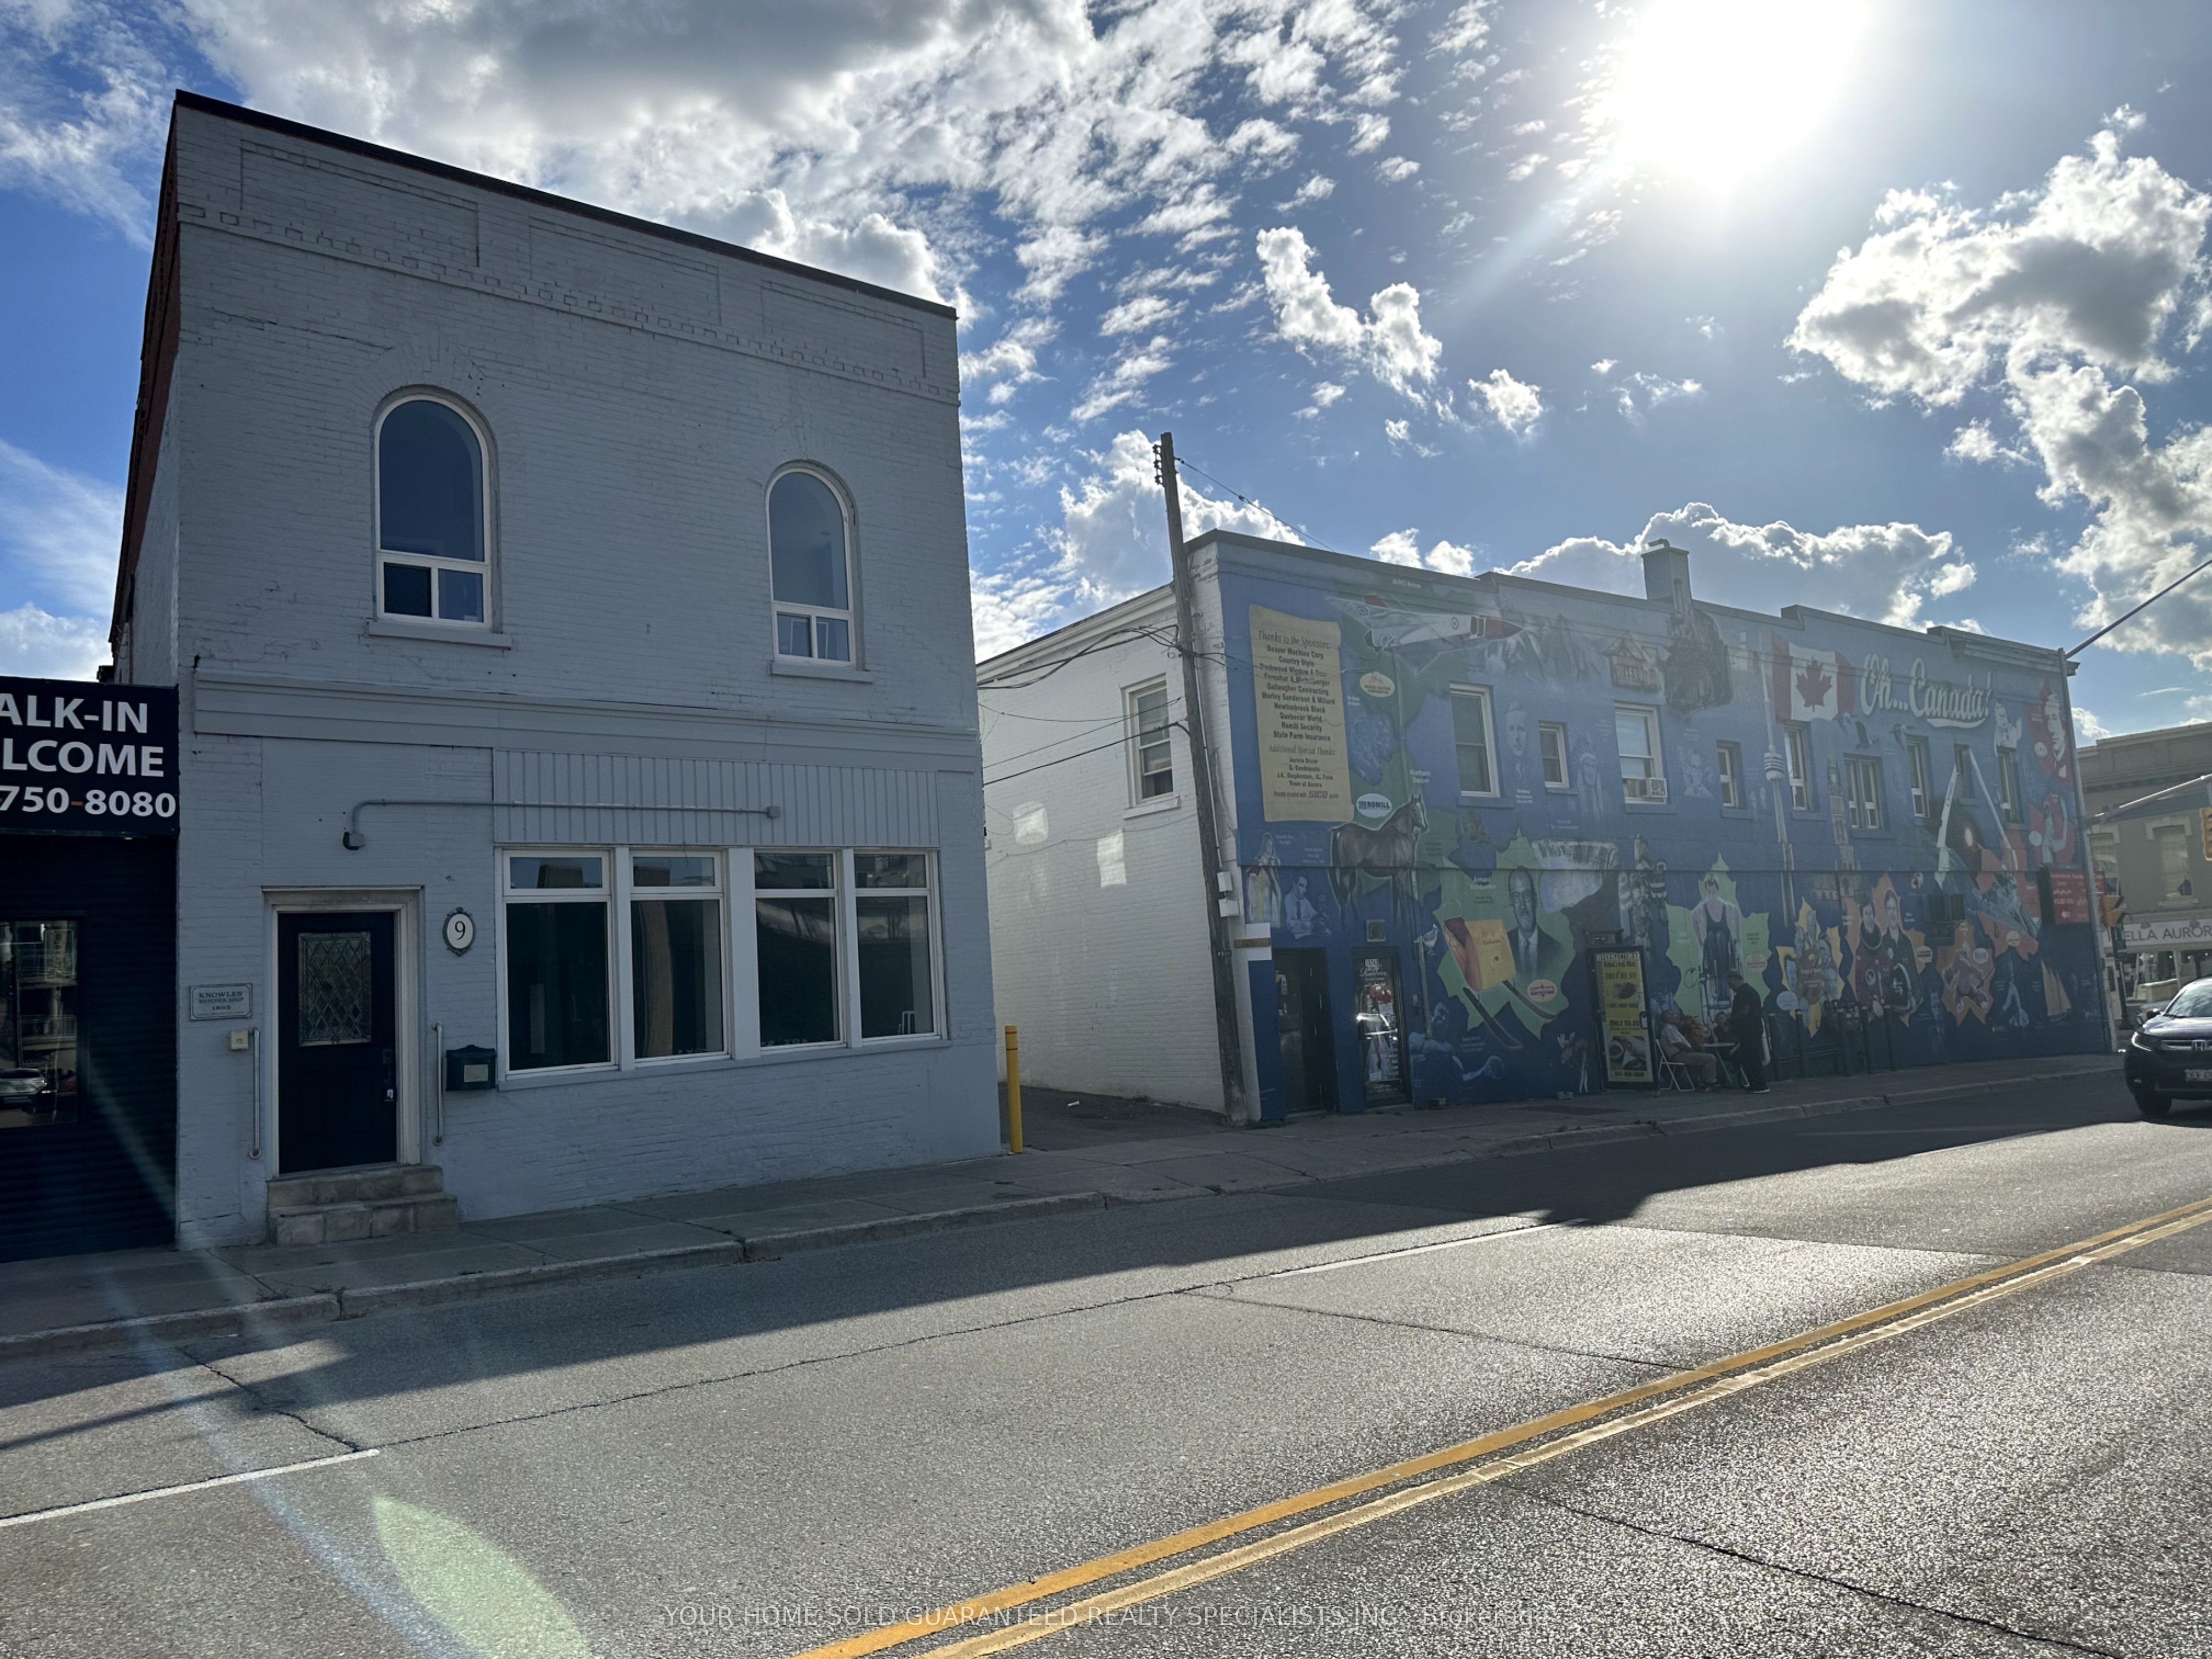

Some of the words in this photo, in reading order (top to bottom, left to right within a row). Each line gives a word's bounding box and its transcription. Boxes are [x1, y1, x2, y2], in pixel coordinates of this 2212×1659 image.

[1258, 630, 1281, 641] Thanks
[1291, 635, 1300, 643] the
[1267, 645, 1286, 653] Beaver
[1287, 647, 1309, 657] Machine
[1310, 651, 1324, 660] Corp
[1279, 656, 1300, 666] Country
[1301, 658, 1314, 667] Style
[1298, 685, 1329, 696] Contracting
[1909, 658, 1991, 720] Canada!
[1282, 693, 1310, 702] Sanderson
[1300, 723, 1322, 733] Security
[1290, 732, 1303, 740] Farm
[1305, 733, 1331, 741] Insurance
[1366, 801, 1391, 809] ROMILL
[454, 921, 465, 941] 9
